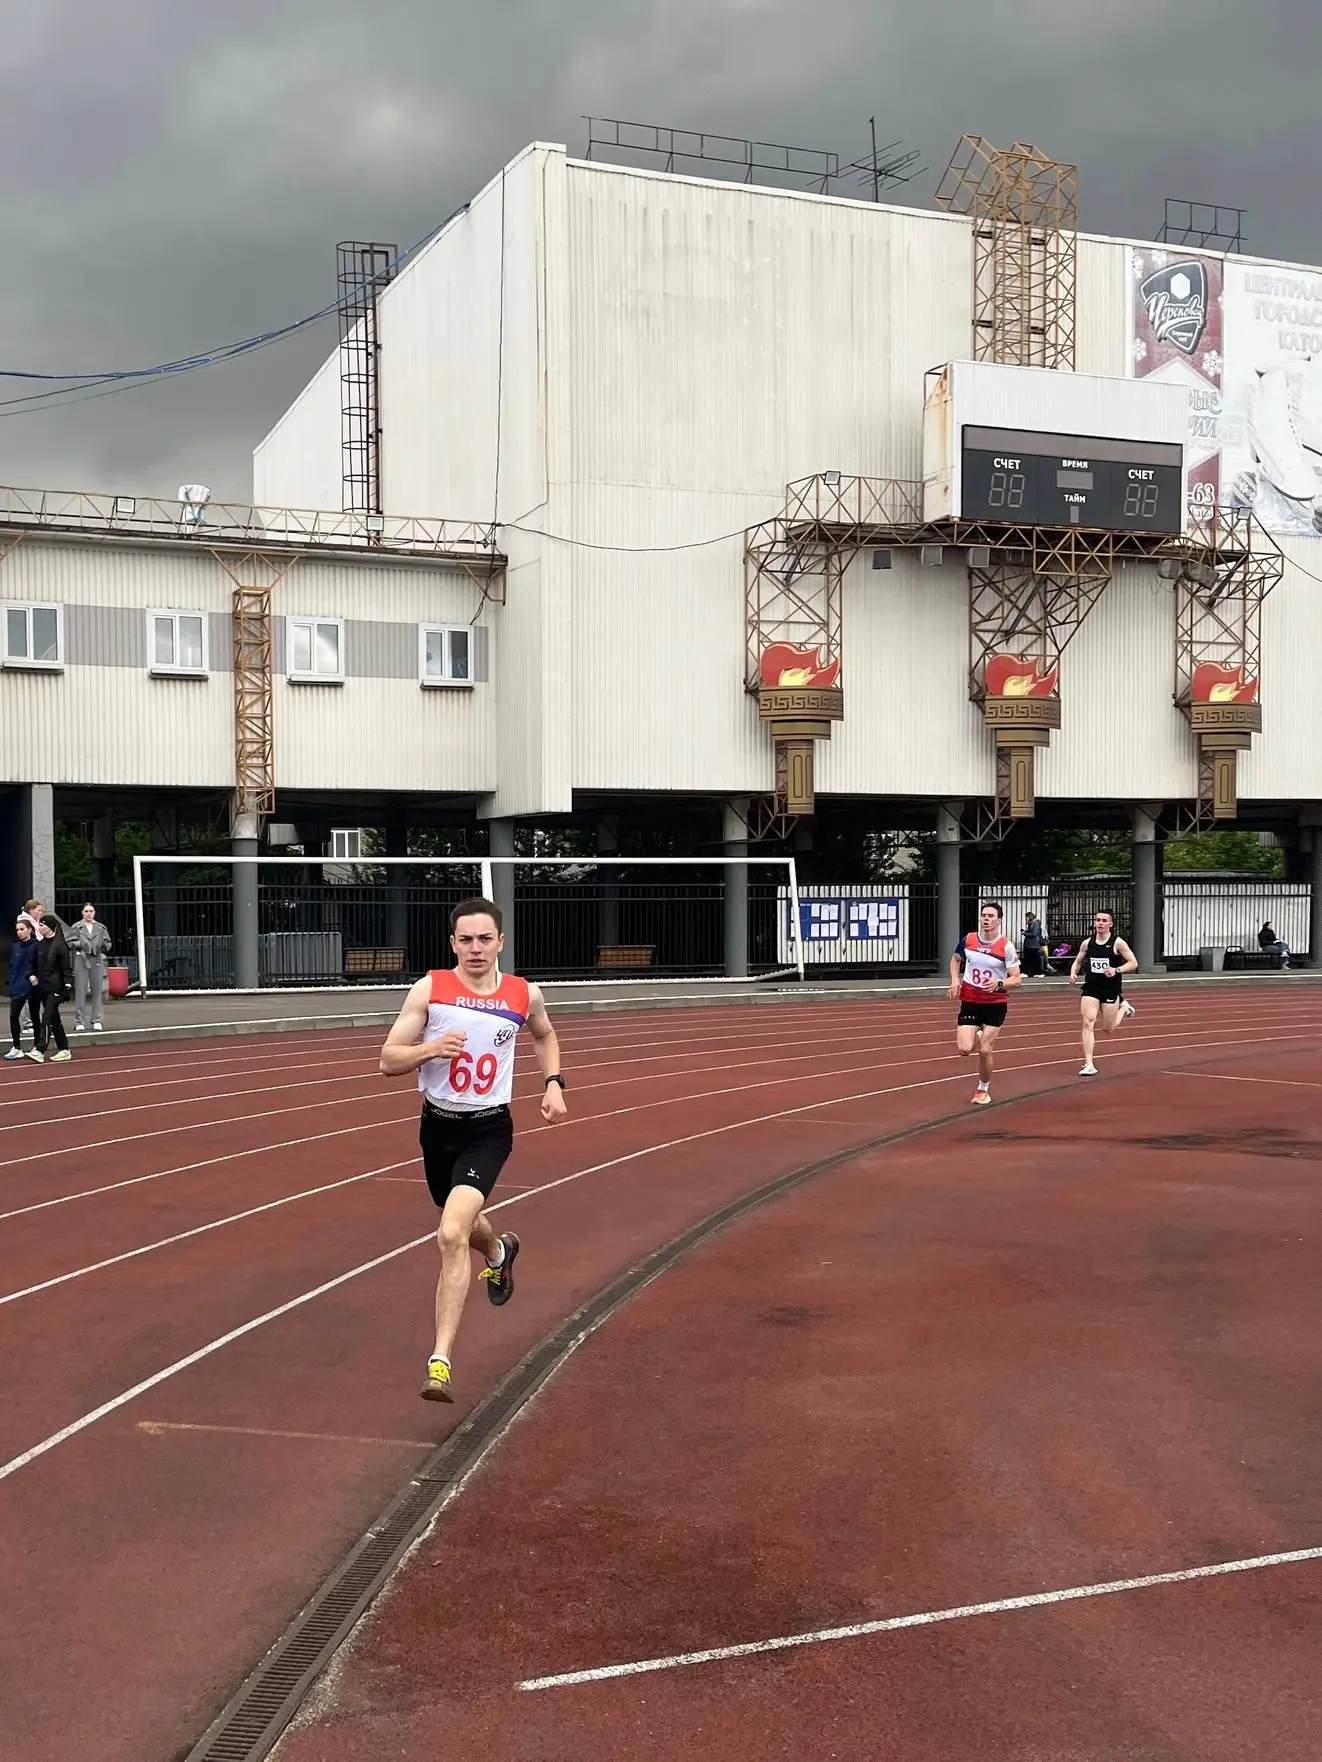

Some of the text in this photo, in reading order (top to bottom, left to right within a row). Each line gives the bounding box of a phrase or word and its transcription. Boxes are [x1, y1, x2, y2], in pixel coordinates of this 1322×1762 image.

[993, 457, 1021, 470] СЧЕТ
[1062, 459, 1088, 469] ВРЕМЯ
[1128, 469, 1154, 480] СЧЕТ
[1064, 494, 1086, 503] ТАЙМ
[455, 996, 510, 1011] RUSSIA
[448, 1051, 498, 1095] 69
